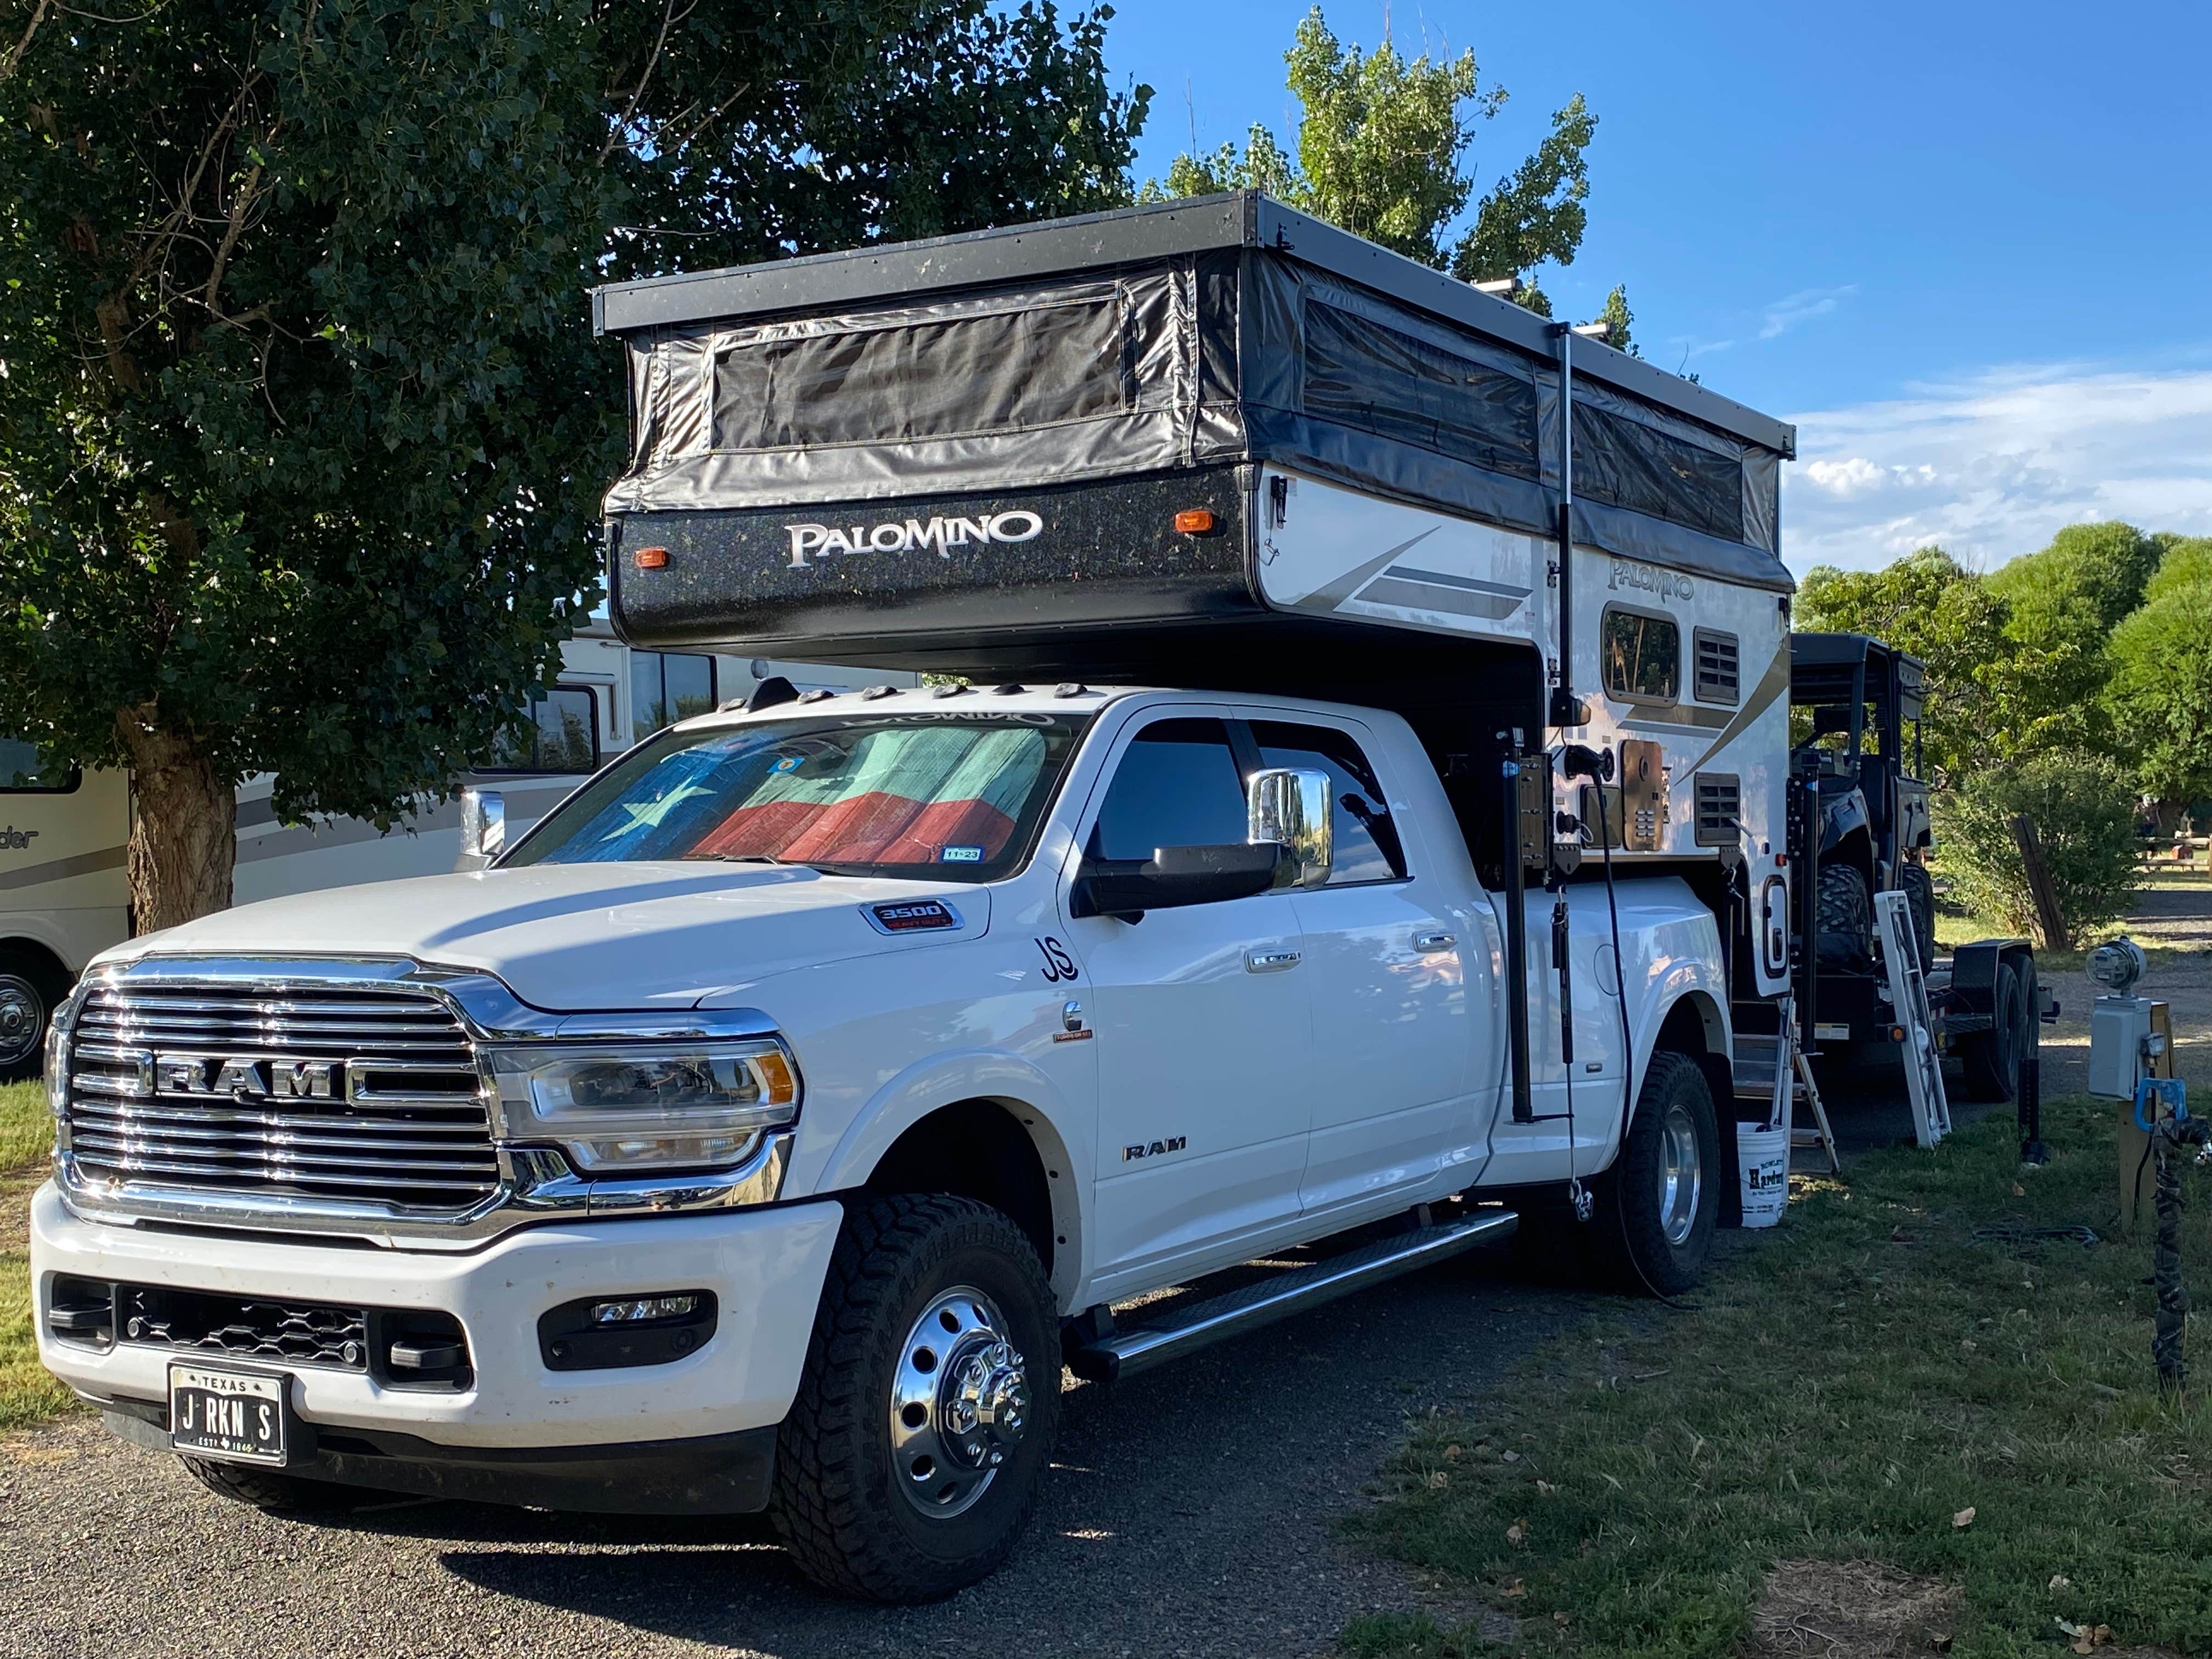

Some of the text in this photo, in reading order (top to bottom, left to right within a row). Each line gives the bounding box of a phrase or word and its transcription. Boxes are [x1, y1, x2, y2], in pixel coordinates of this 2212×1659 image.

[784, 510, 1043, 568] PALOMINO
[1607, 559, 1695, 604] PALOMINO
[879, 905, 942, 919] 3500
[156, 1058, 331, 1097] RAM
[1122, 1136, 1186, 1162] RAM
[202, 1376, 246, 1392] TEXAS
[183, 1394, 270, 1440] J RKN S
